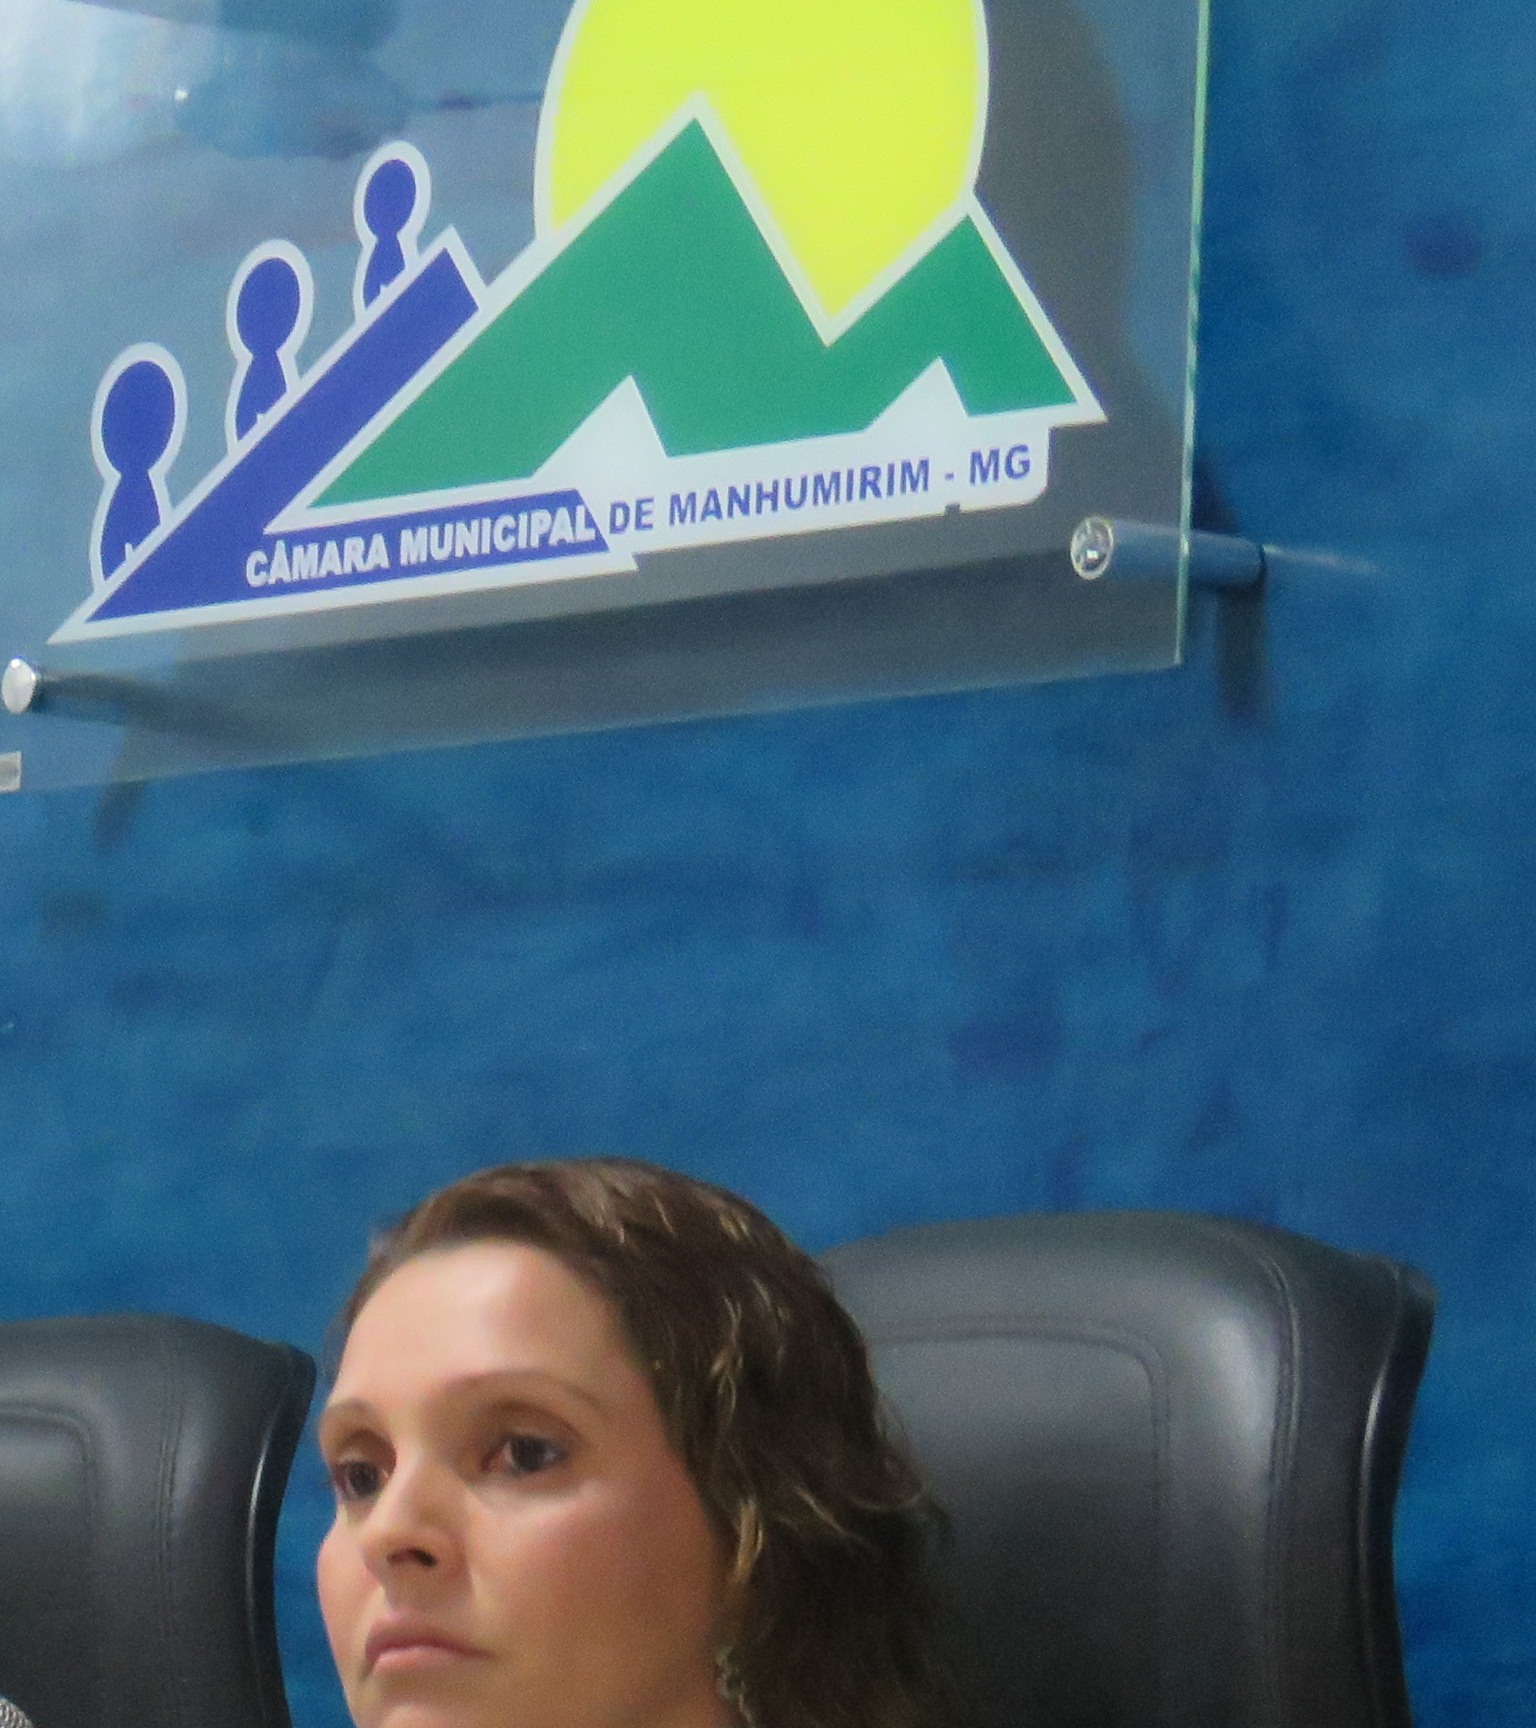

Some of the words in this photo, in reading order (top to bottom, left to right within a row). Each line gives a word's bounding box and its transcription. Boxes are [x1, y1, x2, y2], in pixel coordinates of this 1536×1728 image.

[245, 532, 390, 588] CÂMARA
[399, 505, 596, 567] MUNICIPAL
[607, 498, 655, 536] DE
[667, 457, 930, 527] MANHUMIRIM
[968, 443, 1033, 487] MG
